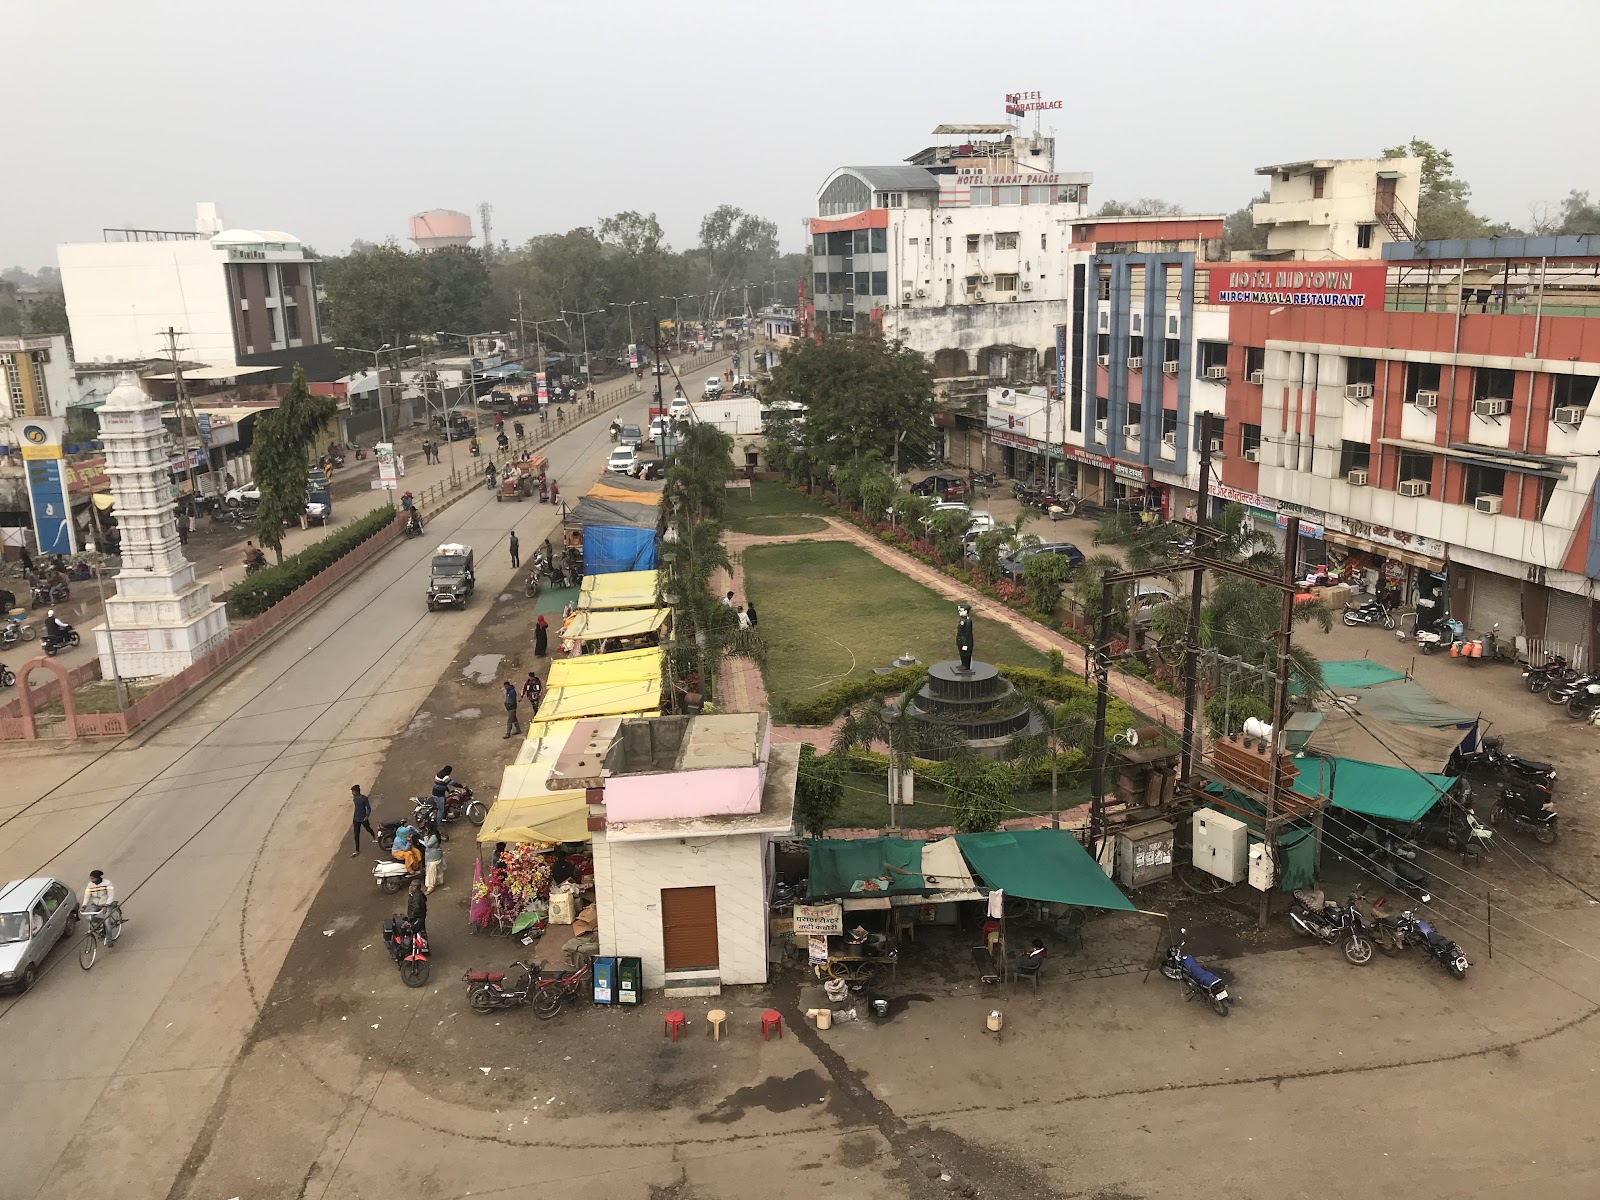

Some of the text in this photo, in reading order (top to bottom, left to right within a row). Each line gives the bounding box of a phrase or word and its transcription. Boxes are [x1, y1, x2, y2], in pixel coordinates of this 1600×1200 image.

[957, 176, 984, 185] HOTEL
[1027, 174, 1060, 184] PALACE
[1229, 271, 1353, 290] HOTEL MIDTOWN
[1219, 291, 1366, 307] MIRCH MASALA RESTAURANT
